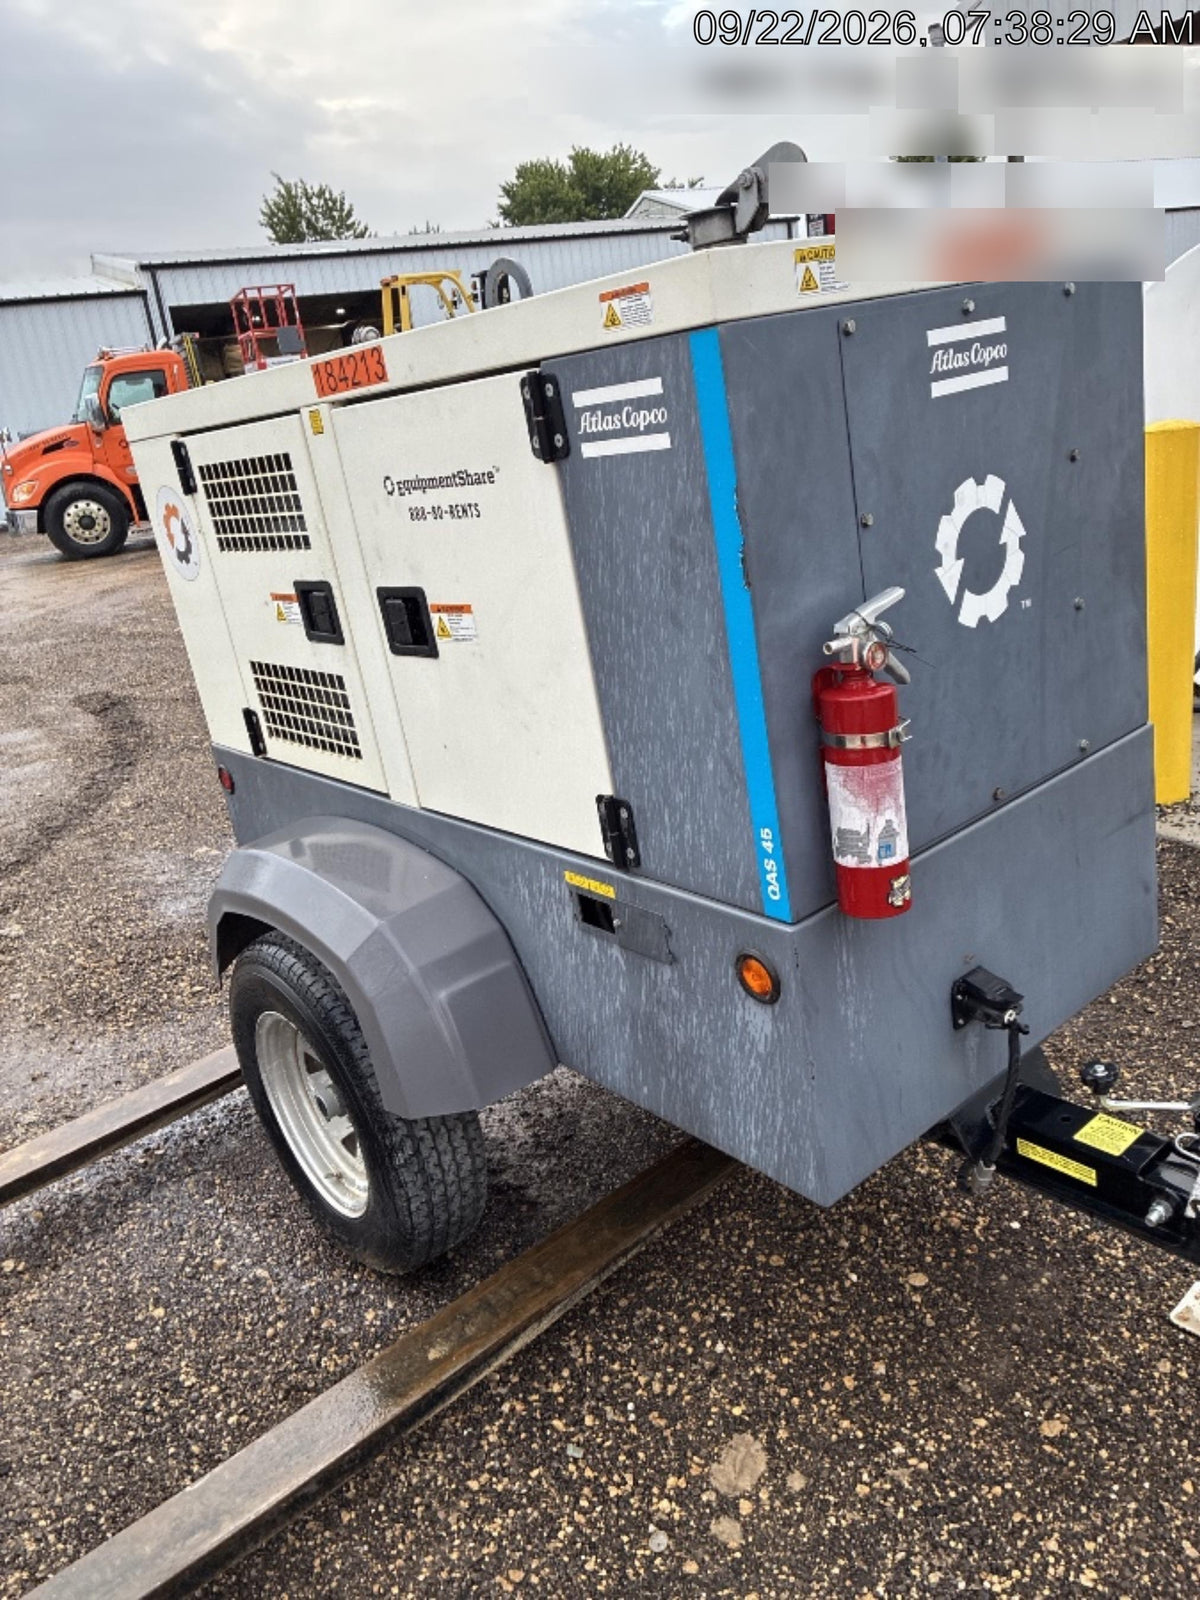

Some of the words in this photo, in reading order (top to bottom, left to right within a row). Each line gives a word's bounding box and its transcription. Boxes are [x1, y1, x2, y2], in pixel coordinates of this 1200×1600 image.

[313, 346, 387, 393] 184213
[929, 348, 970, 374] Atlas
[970, 342, 1007, 367] Copco
[577, 410, 621, 434] Atlas
[621, 406, 668, 431] Copco
[760, 827, 774, 854] 45
[763, 858, 781, 901] QAS
[1098, 1116, 1140, 1136] CAUTION
